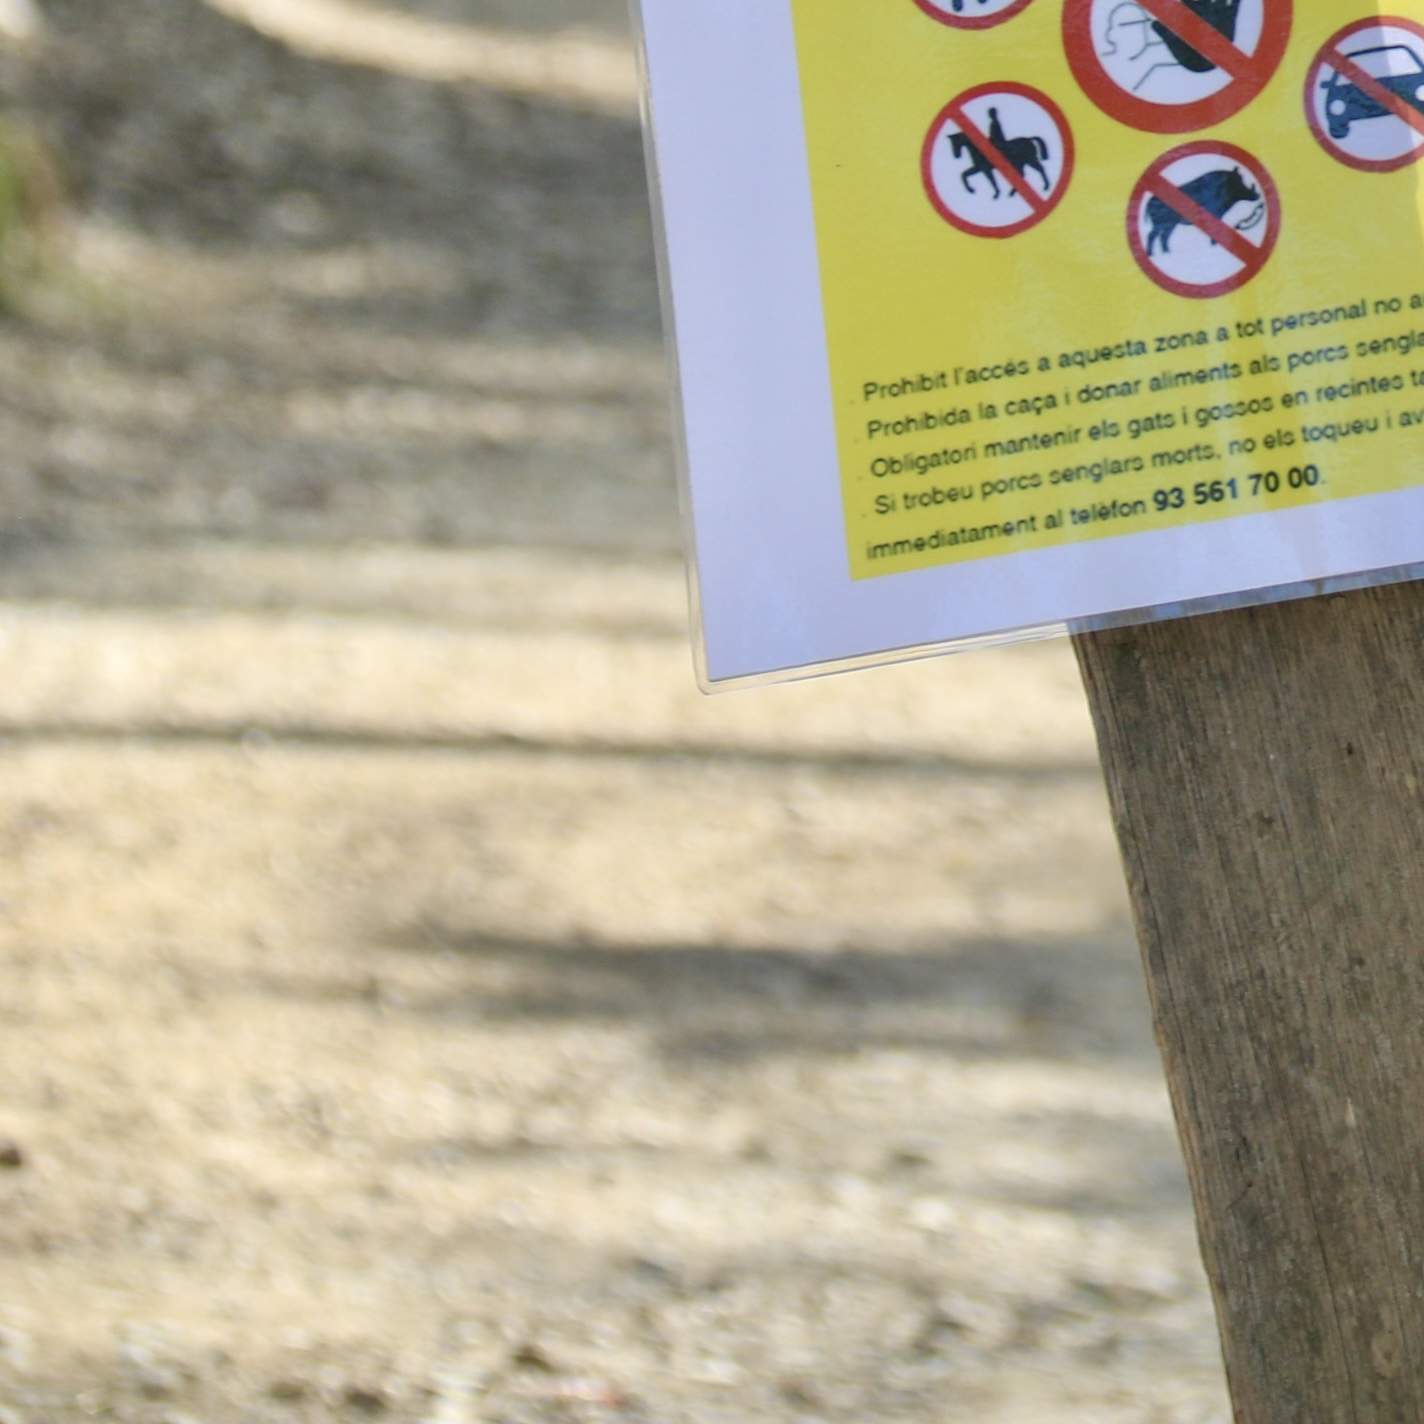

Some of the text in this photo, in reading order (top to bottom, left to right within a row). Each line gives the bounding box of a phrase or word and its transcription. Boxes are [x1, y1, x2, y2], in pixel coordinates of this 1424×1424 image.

[862, 371, 948, 402] Prohibit
[1036, 355, 1052, 372] a
[1057, 338, 1148, 369] aquesta
[1153, 329, 1210, 353] zona
[1215, 326, 1230, 342] a
[1234, 317, 1265, 339] tot
[1270, 298, 1368, 337] personal
[1373, 297, 1402, 314] no
[866, 407, 972, 440] Prohibida
[977, 402, 999, 420] la
[1003, 393, 1059, 416] caça
[1063, 391, 1071, 405] i
[1075, 378, 1142, 404] donar
[1148, 362, 1243, 392] aliments
[1248, 354, 1281, 375] als
[1286, 344, 1350, 373] porcs
[869, 442, 977, 478] Obligatori
[983, 427, 1082, 458] mantenir
[1087, 419, 1121, 441] els
[1126, 412, 1176, 439] gats
[1181, 405, 1189, 426] i
[1193, 395, 1275, 429] gossos
[1280, 390, 1309, 409] en
[1315, 373, 1405, 402] recintes
[874, 493, 897, 515] Si
[902, 484, 974, 510] trobeu
[979, 472, 1043, 501] porcs
[1048, 455, 1145, 486] senglars
[1228, 437, 1257, 455] no
[1261, 428, 1296, 450] els
[1300, 416, 1379, 443] toqueu
[1385, 411, 1392, 429] i
[866, 515, 1037, 559] immediatament
[1043, 509, 1063, 530] al
[1151, 485, 1186, 512] 93
[1192, 477, 1238, 505] 561
[1247, 469, 1281, 496] 70
